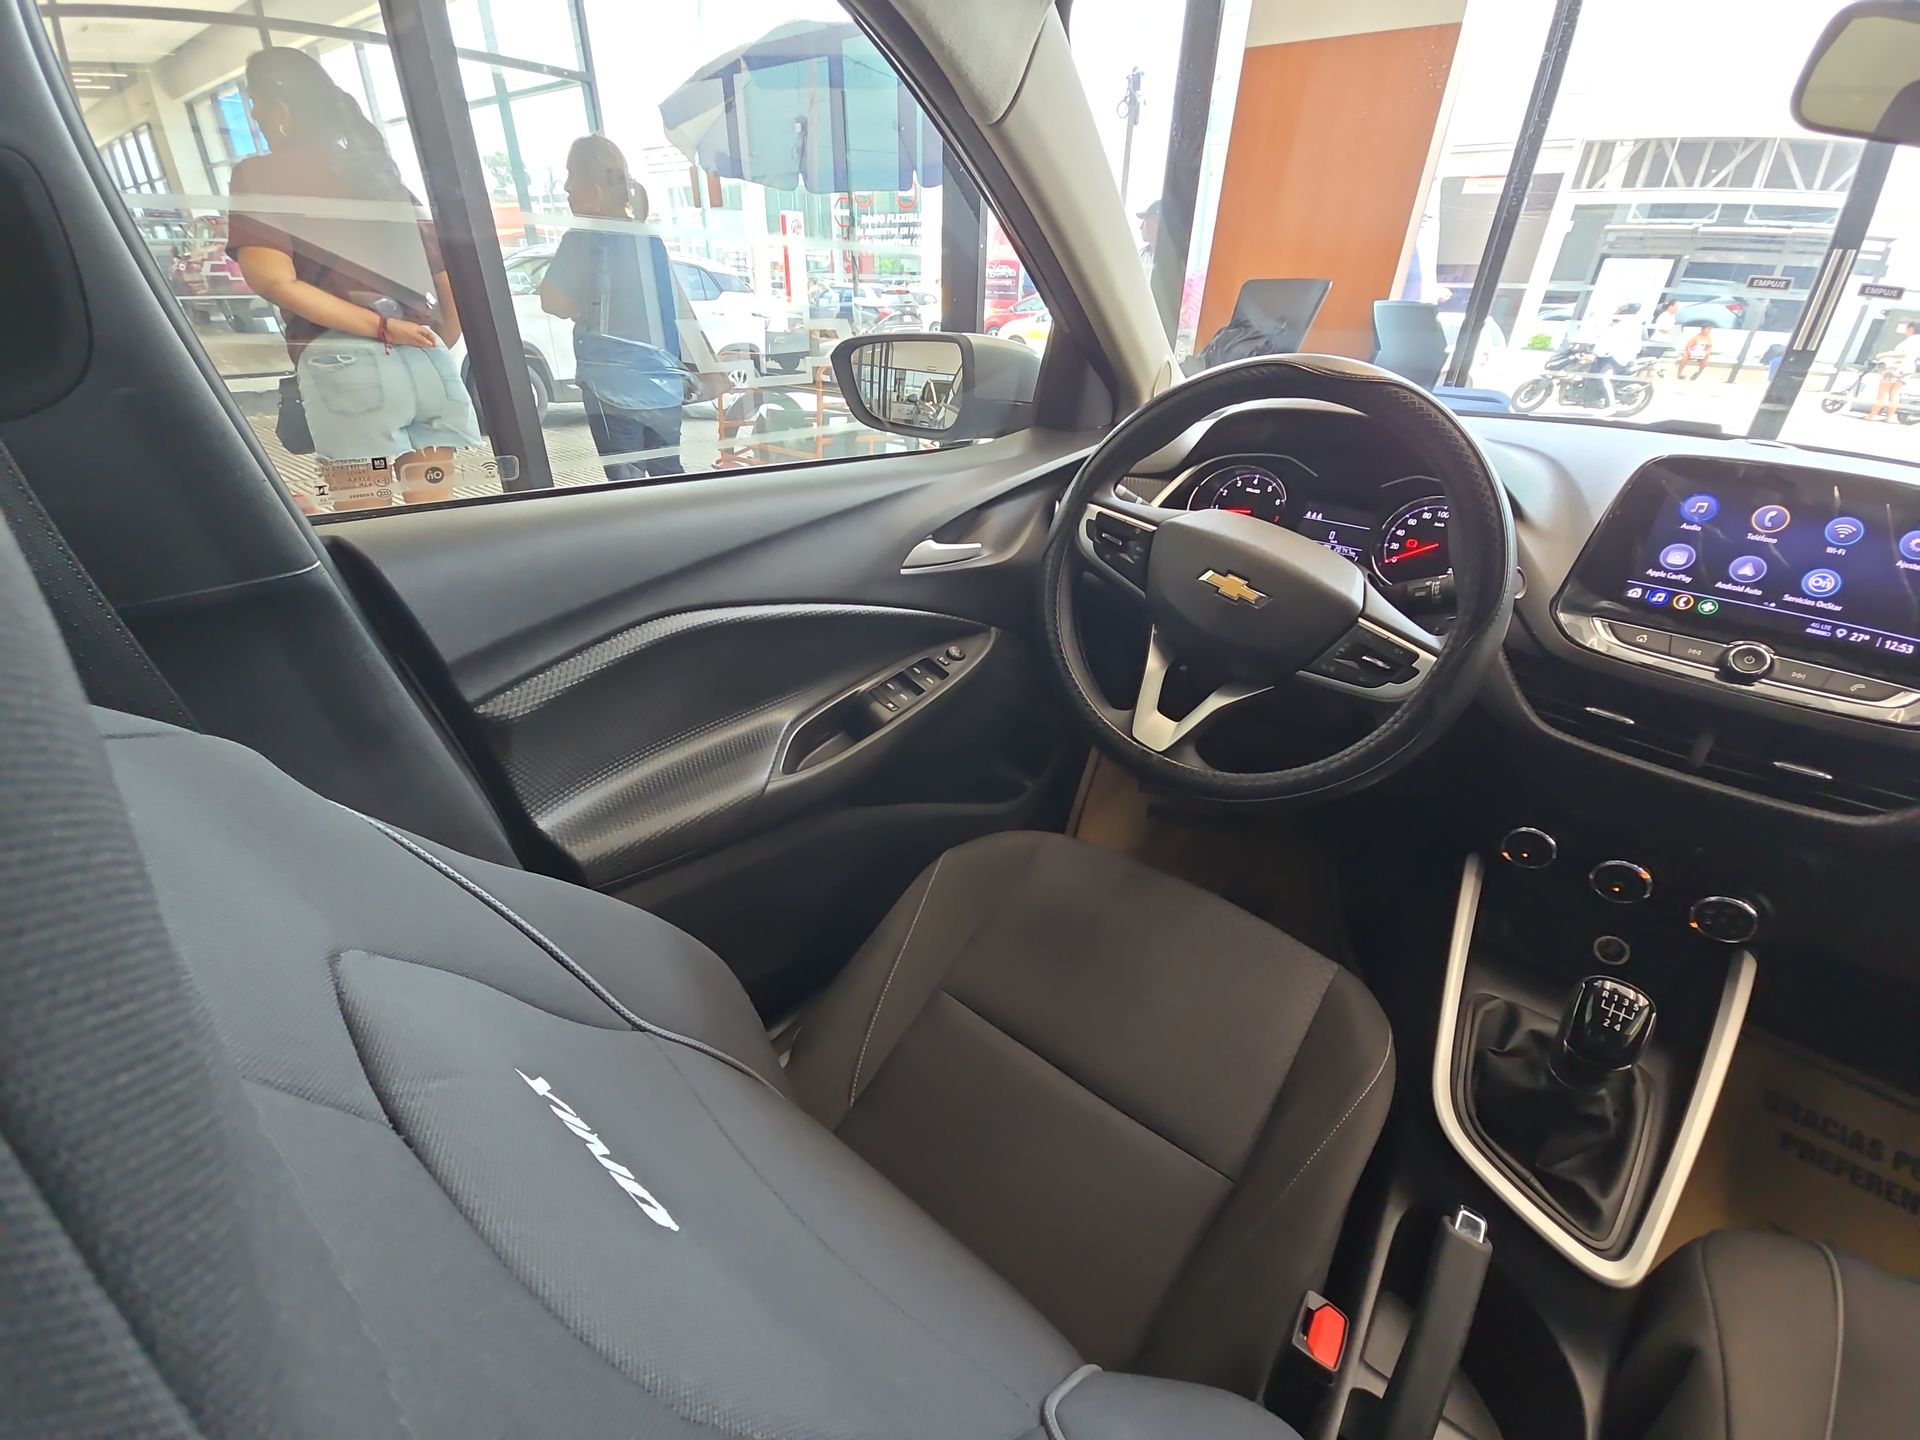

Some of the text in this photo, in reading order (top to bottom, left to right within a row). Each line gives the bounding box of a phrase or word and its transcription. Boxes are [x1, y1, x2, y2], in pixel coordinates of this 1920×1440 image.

[1752, 279, 1787, 289] EMPUJE
[1863, 286, 1899, 297] EMPUJE
[1422, 511, 1432, 519] 80
[1407, 518, 1417, 526] 60
[1680, 522, 1702, 532] Audio
[1746, 532, 1779, 545] Teléfono
[1389, 542, 1400, 550] 20
[1825, 546, 1847, 556] Wi-Fi
[1646, 568, 1693, 584] Apple CarPlay
[1714, 581, 1763, 596] Android Auto
[1782, 593, 1843, 612] Servicios OnStar
[1884, 640, 1915, 654] 12:53
[1602, 990, 1639, 1012] R 1 3 5
[1602, 1018, 1621, 1032] 2 4
[1764, 1089, 1885, 1162] GRACIAS
